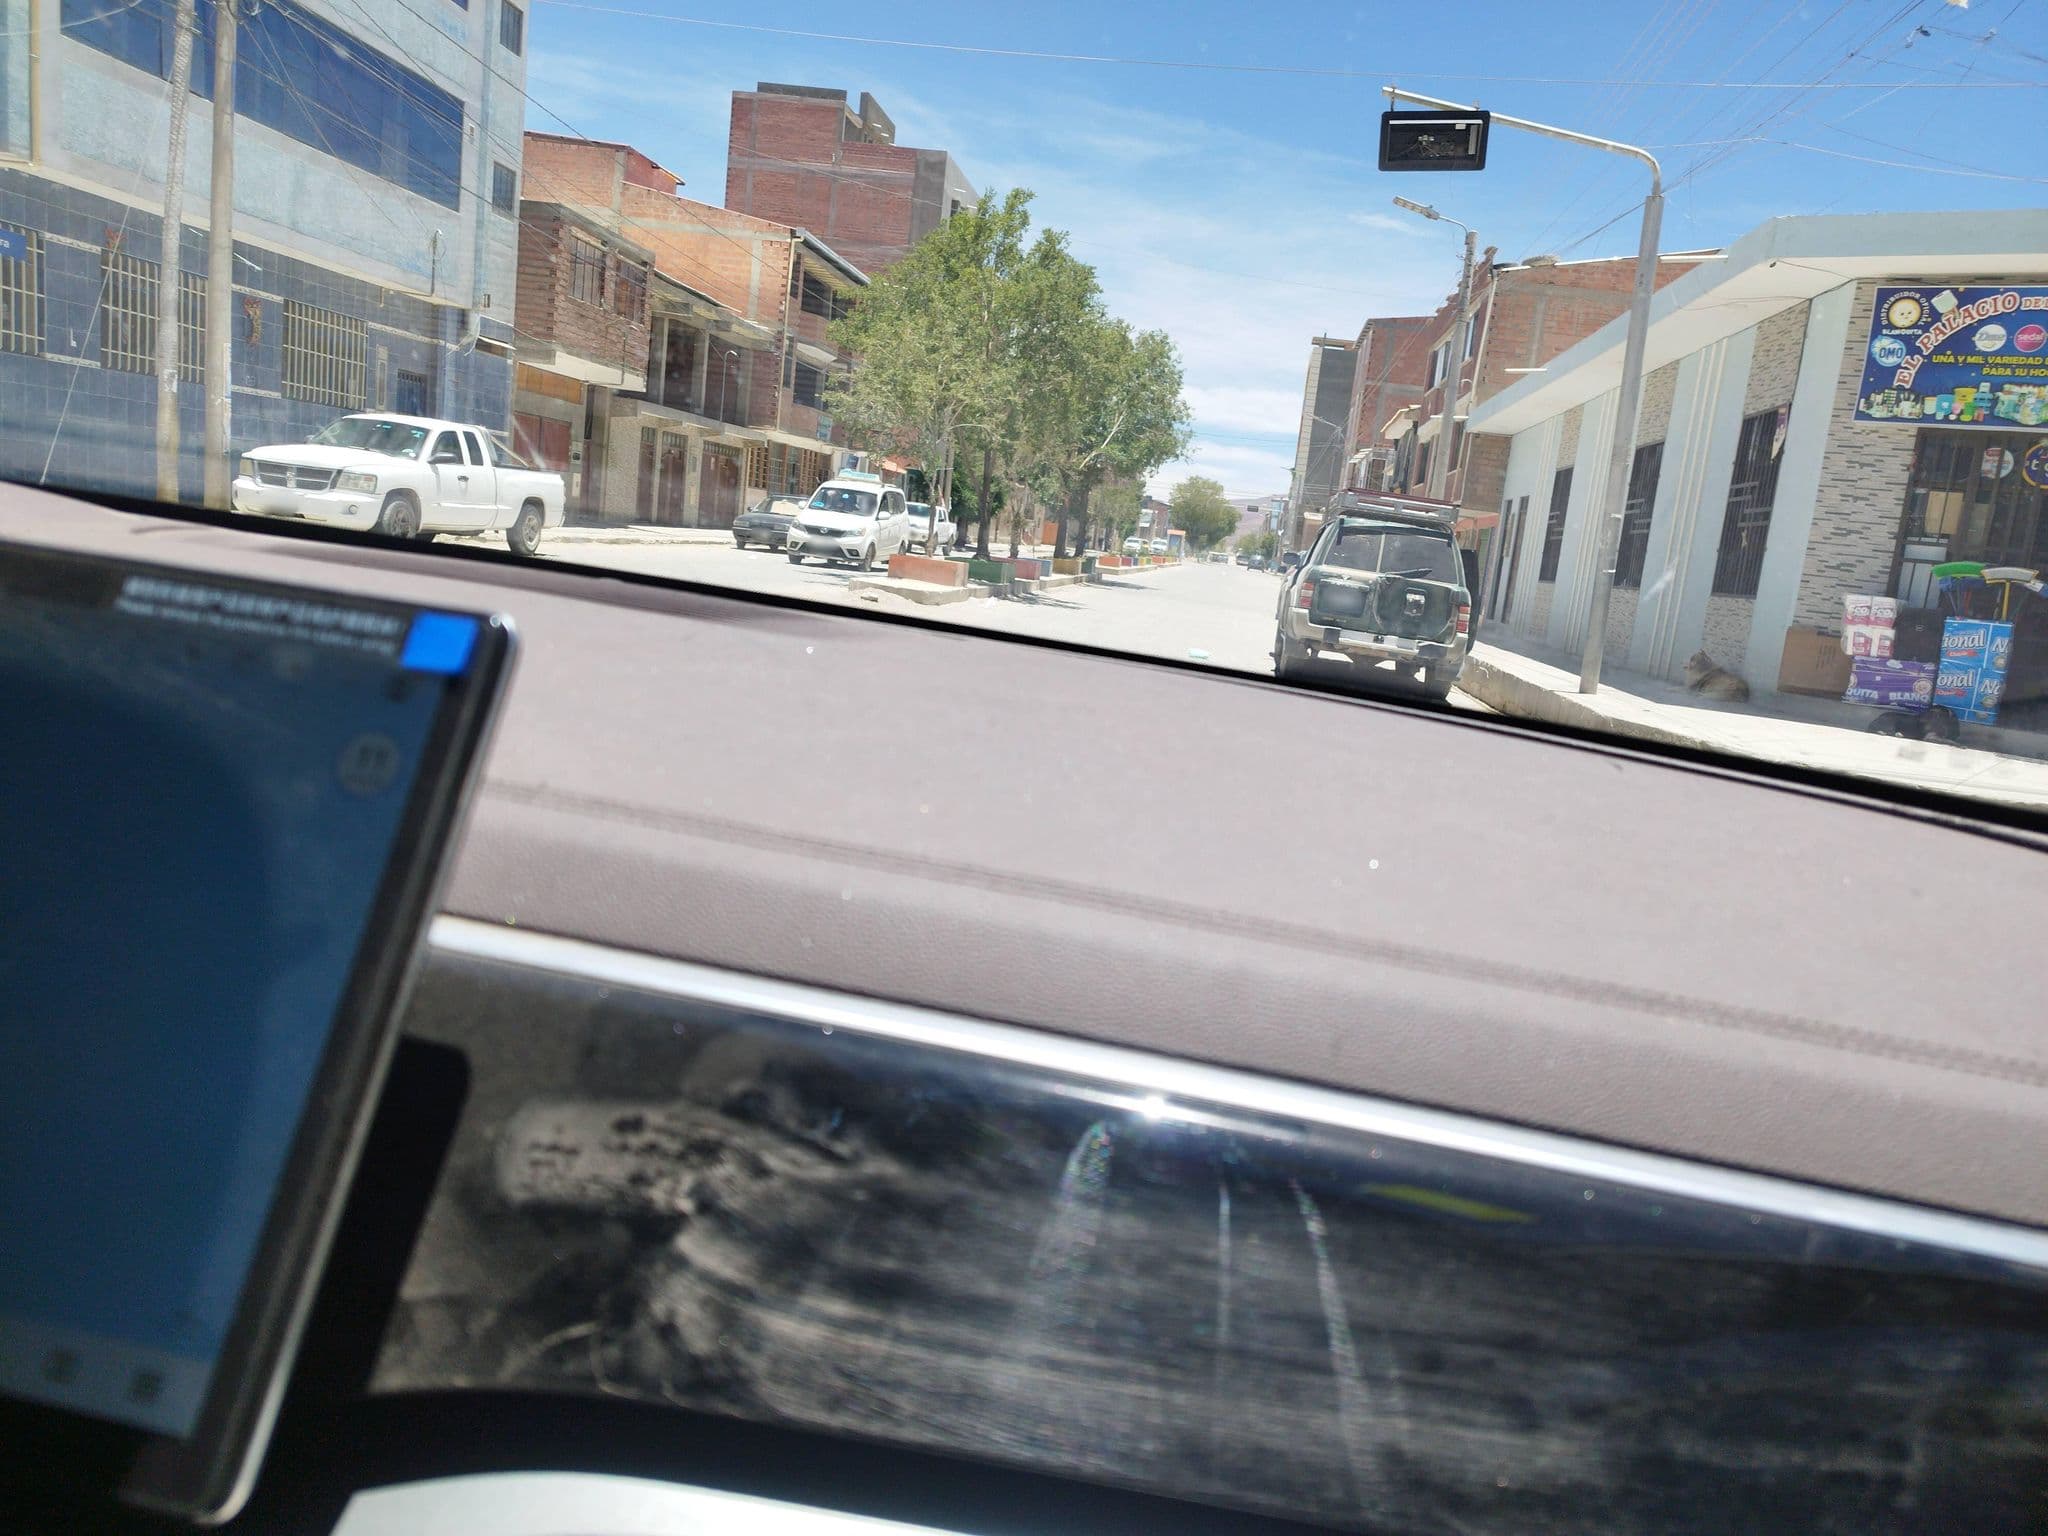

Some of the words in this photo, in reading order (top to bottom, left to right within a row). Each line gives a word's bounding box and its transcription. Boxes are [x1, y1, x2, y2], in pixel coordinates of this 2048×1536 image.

[1880, 291, 1920, 325] DISTRIBUIDOR
[1894, 355, 1923, 388] EL
[1916, 292, 2020, 355] PALACIO
[1879, 347, 1903, 360] OMO
[1932, 355, 1954, 364] UNA
[1957, 355, 1965, 364] Y
[1967, 355, 1985, 364] MIL
[1988, 356, 2043, 365] VARIEDAD
[1983, 367, 2012, 376] PARA
[2015, 368, 2029, 376] SU
